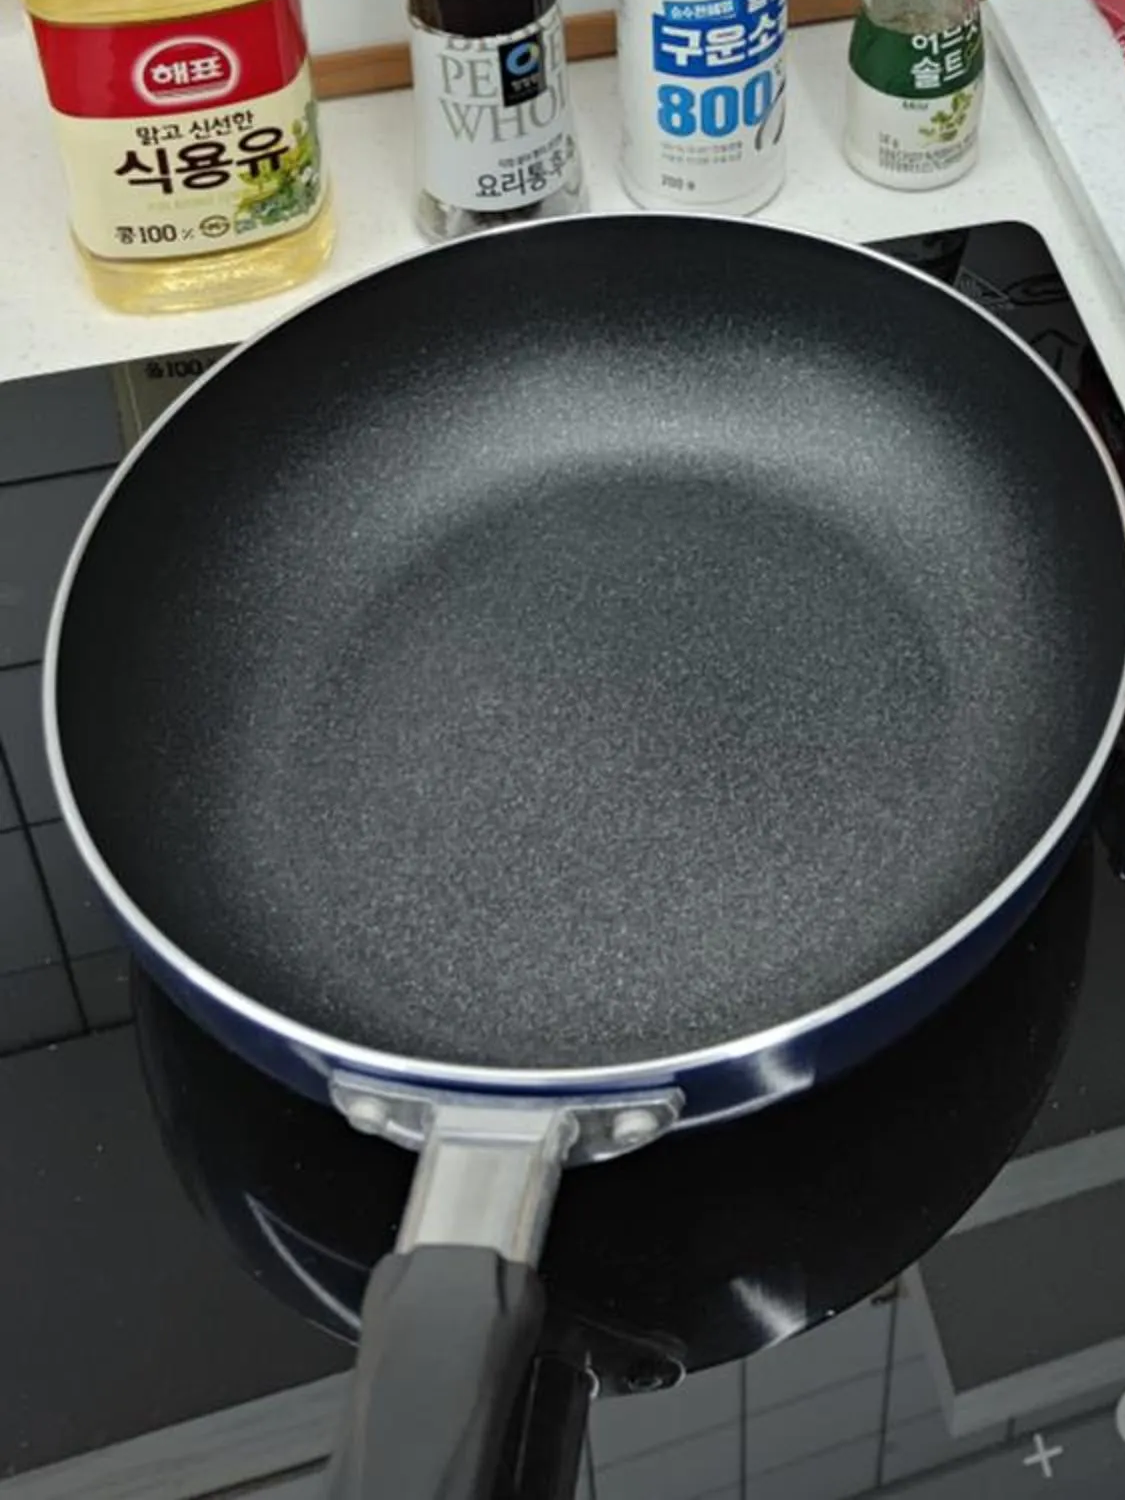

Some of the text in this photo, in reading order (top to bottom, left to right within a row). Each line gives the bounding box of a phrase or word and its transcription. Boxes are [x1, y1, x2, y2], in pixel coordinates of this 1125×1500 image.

[661, 12, 786, 67] 구운소
[151, 54, 226, 85] 해표
[911, 49, 967, 90] 솔트
[136, 110, 255, 146] 맑고 신선한
[115, 127, 290, 194] 식용유
